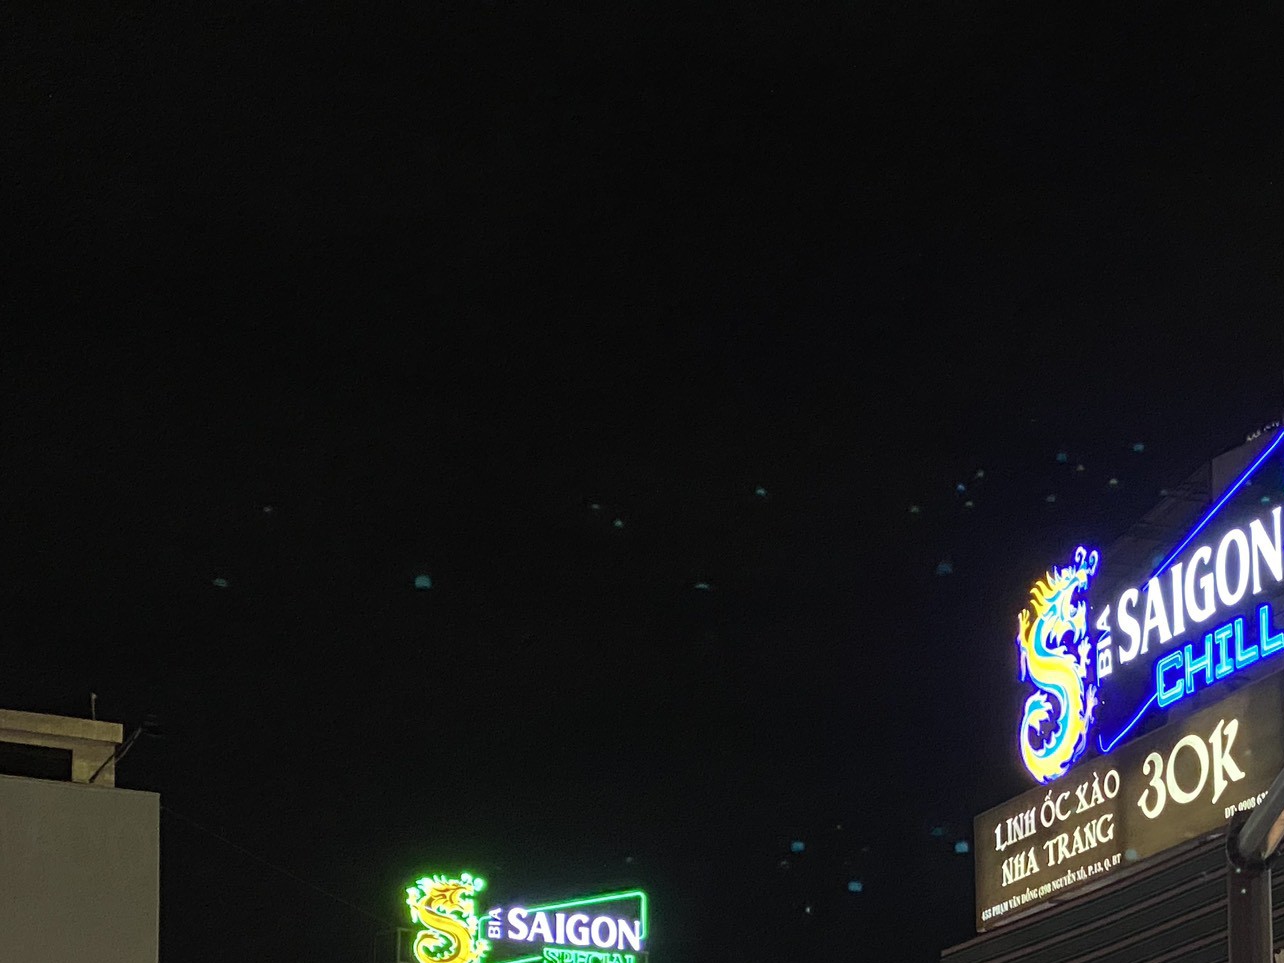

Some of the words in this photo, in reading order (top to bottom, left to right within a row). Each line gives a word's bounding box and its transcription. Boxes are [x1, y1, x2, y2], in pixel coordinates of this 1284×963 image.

[1117, 506, 1284, 664] SAIGON
[1097, 604, 1115, 677] BIA
[994, 806, 1038, 852] LINH
[1040, 789, 1071, 829] ỐC
[1075, 769, 1121, 814] XÀO
[1001, 846, 1040, 888] NHA
[1043, 813, 1115, 867] TRANG
[1112, 853, 1122, 866] BT
[487, 907, 503, 939] BIA
[507, 907, 641, 951] SAIGON
